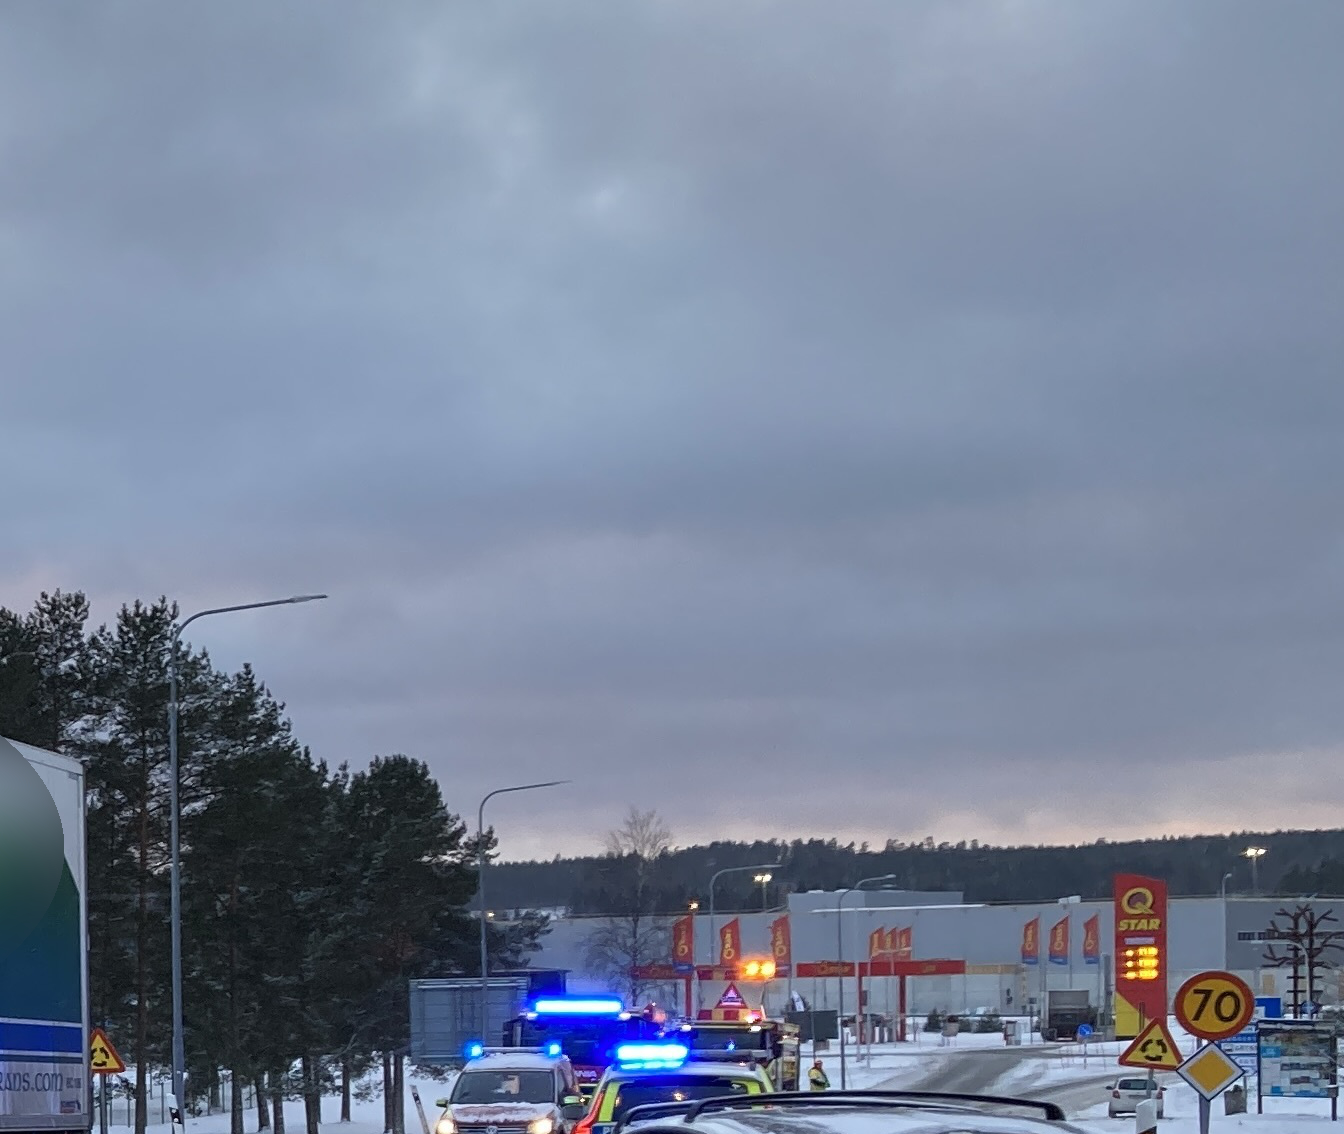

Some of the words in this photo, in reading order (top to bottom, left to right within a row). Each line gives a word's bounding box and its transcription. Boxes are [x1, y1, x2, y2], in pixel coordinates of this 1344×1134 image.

[1121, 887, 1154, 915] Q
[1118, 918, 1161, 931] STAR
[1191, 988, 1241, 1023] 70
